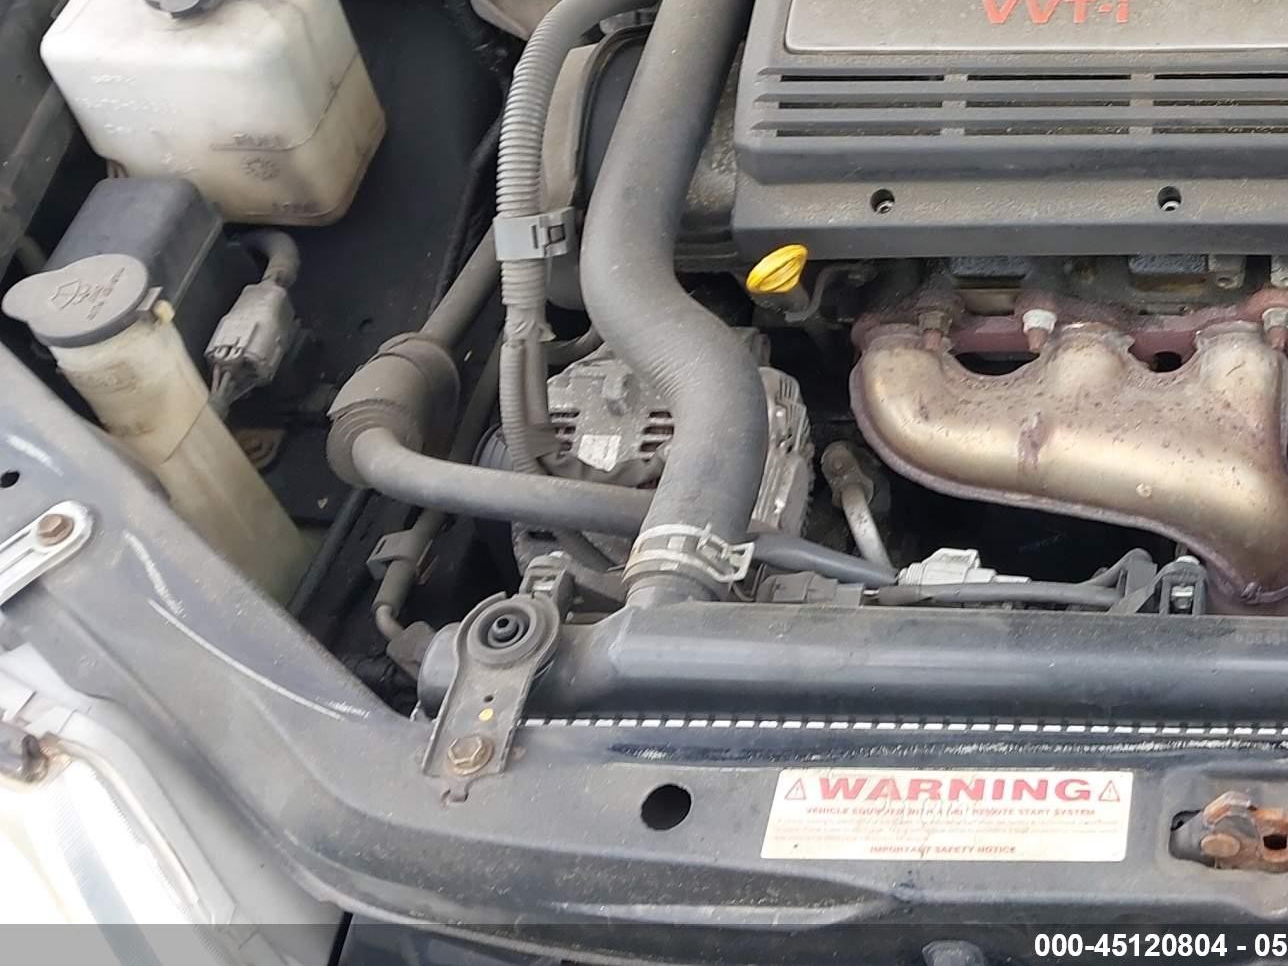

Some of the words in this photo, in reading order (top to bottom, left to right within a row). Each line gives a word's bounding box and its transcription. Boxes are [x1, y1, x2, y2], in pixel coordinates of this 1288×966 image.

[819, 777, 1092, 801] WARNING
[870, 846, 931, 854] IMPORTANT
[935, 846, 975, 854] SAFETY
[977, 846, 1016, 854] NOTICE
